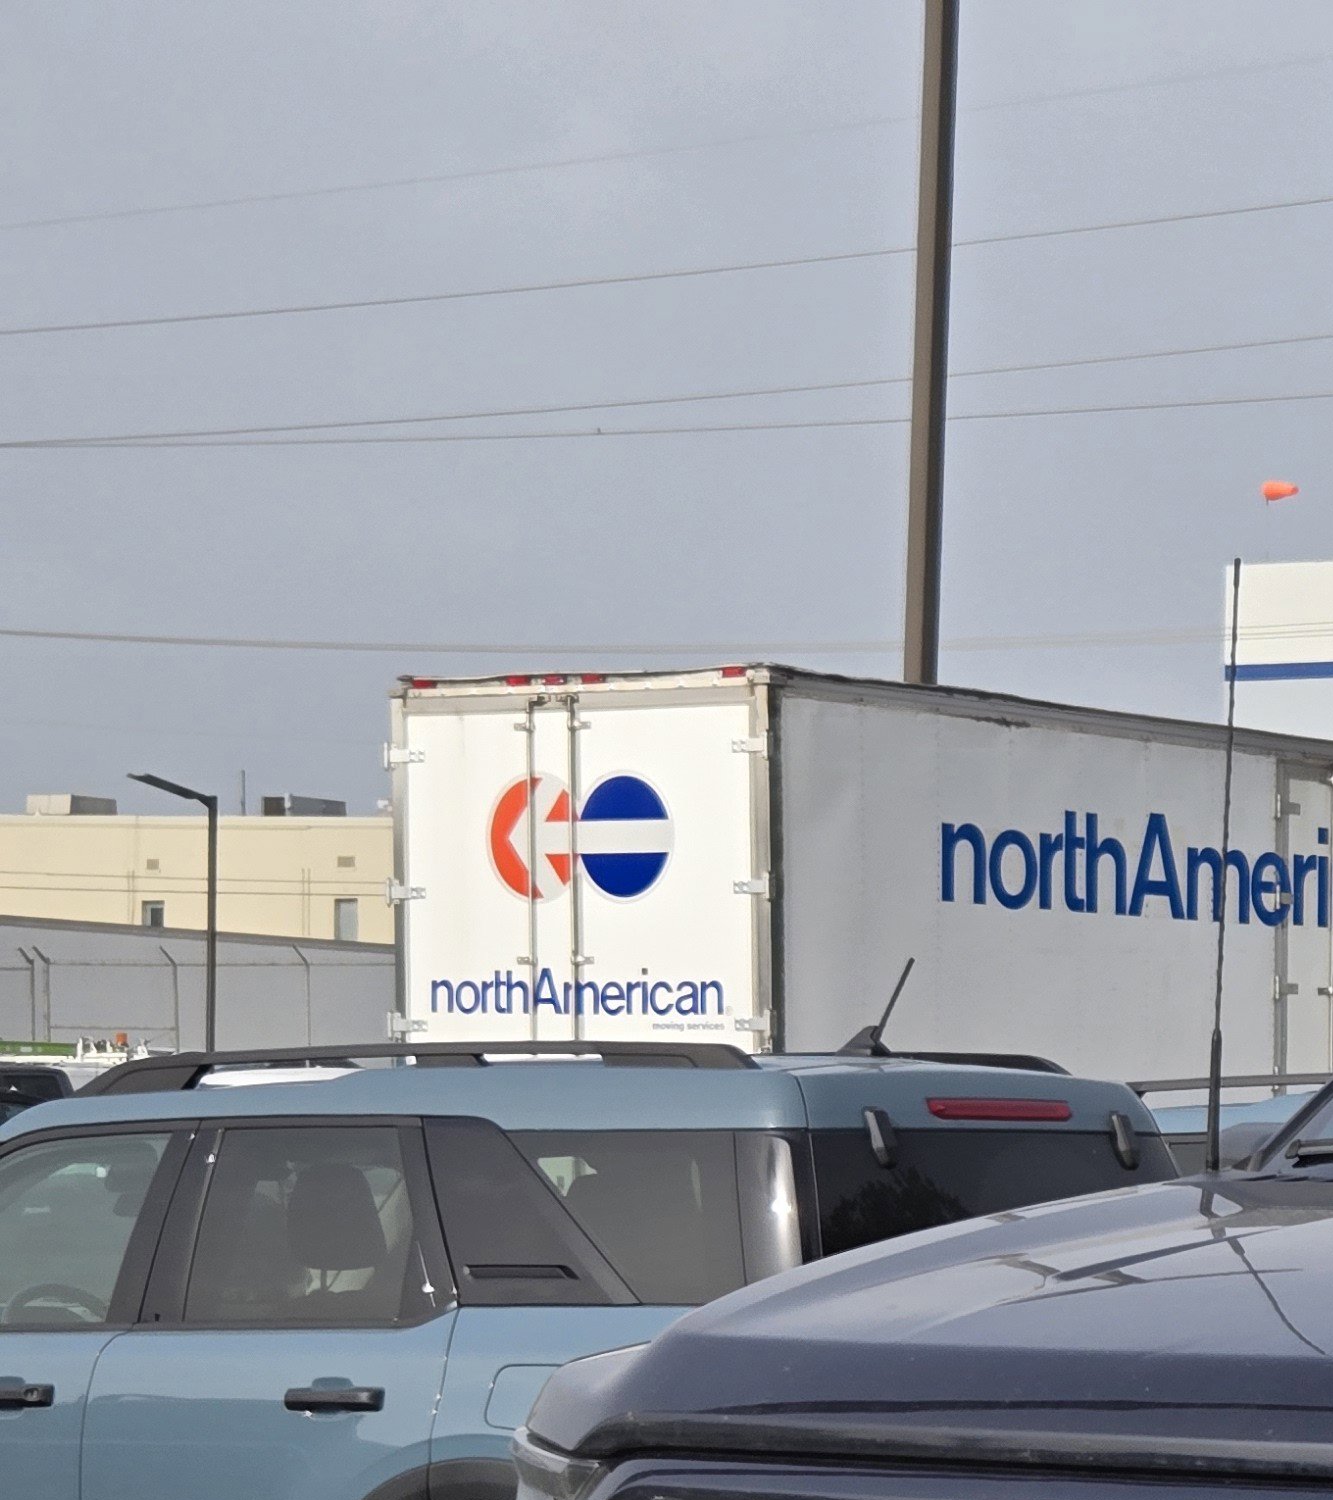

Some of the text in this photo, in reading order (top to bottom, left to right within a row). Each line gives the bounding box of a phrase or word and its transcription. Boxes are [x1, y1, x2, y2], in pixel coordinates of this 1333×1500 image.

[431, 967, 724, 1016] northAmerican
[652, 1021, 725, 1032] moving services
